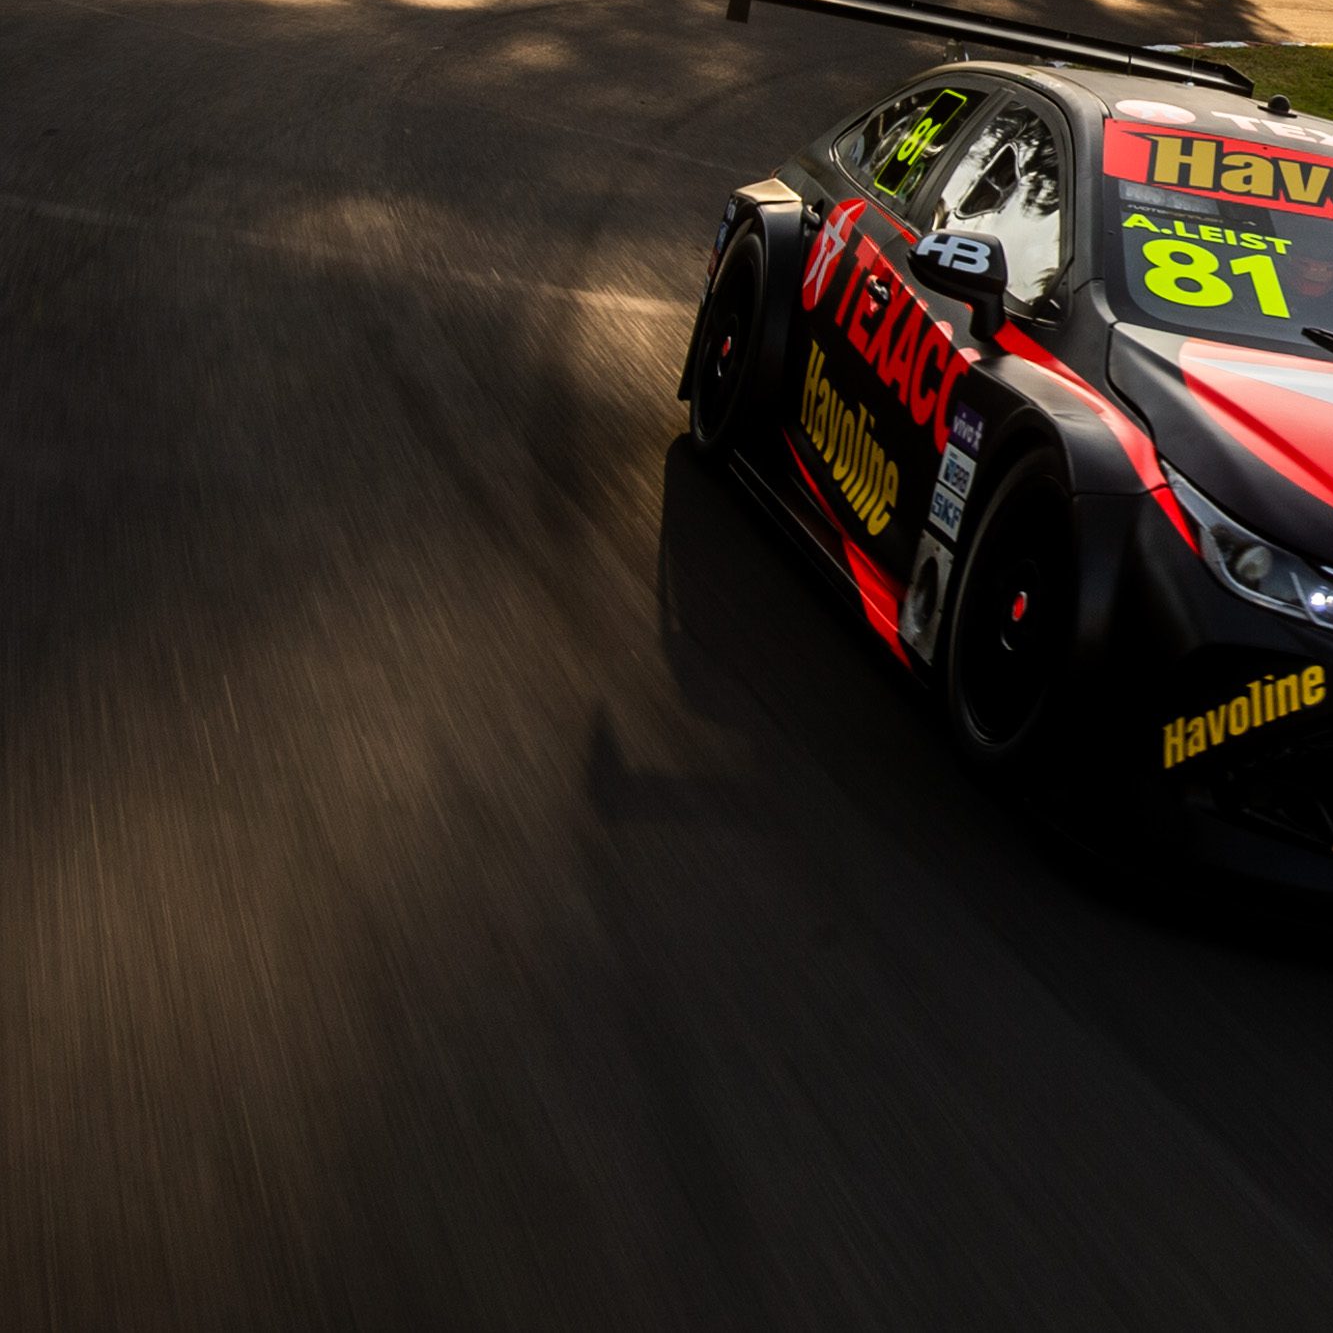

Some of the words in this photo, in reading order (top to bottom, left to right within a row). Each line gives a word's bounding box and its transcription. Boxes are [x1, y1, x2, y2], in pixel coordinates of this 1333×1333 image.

[897, 118, 942, 165] 81
[1122, 213, 1292, 255] A.LEIST
[1143, 239, 1291, 319] 81
[801, 339, 899, 536] Havoline
[932, 492, 962, 529] SKF
[1163, 665, 1326, 769] Havoline
